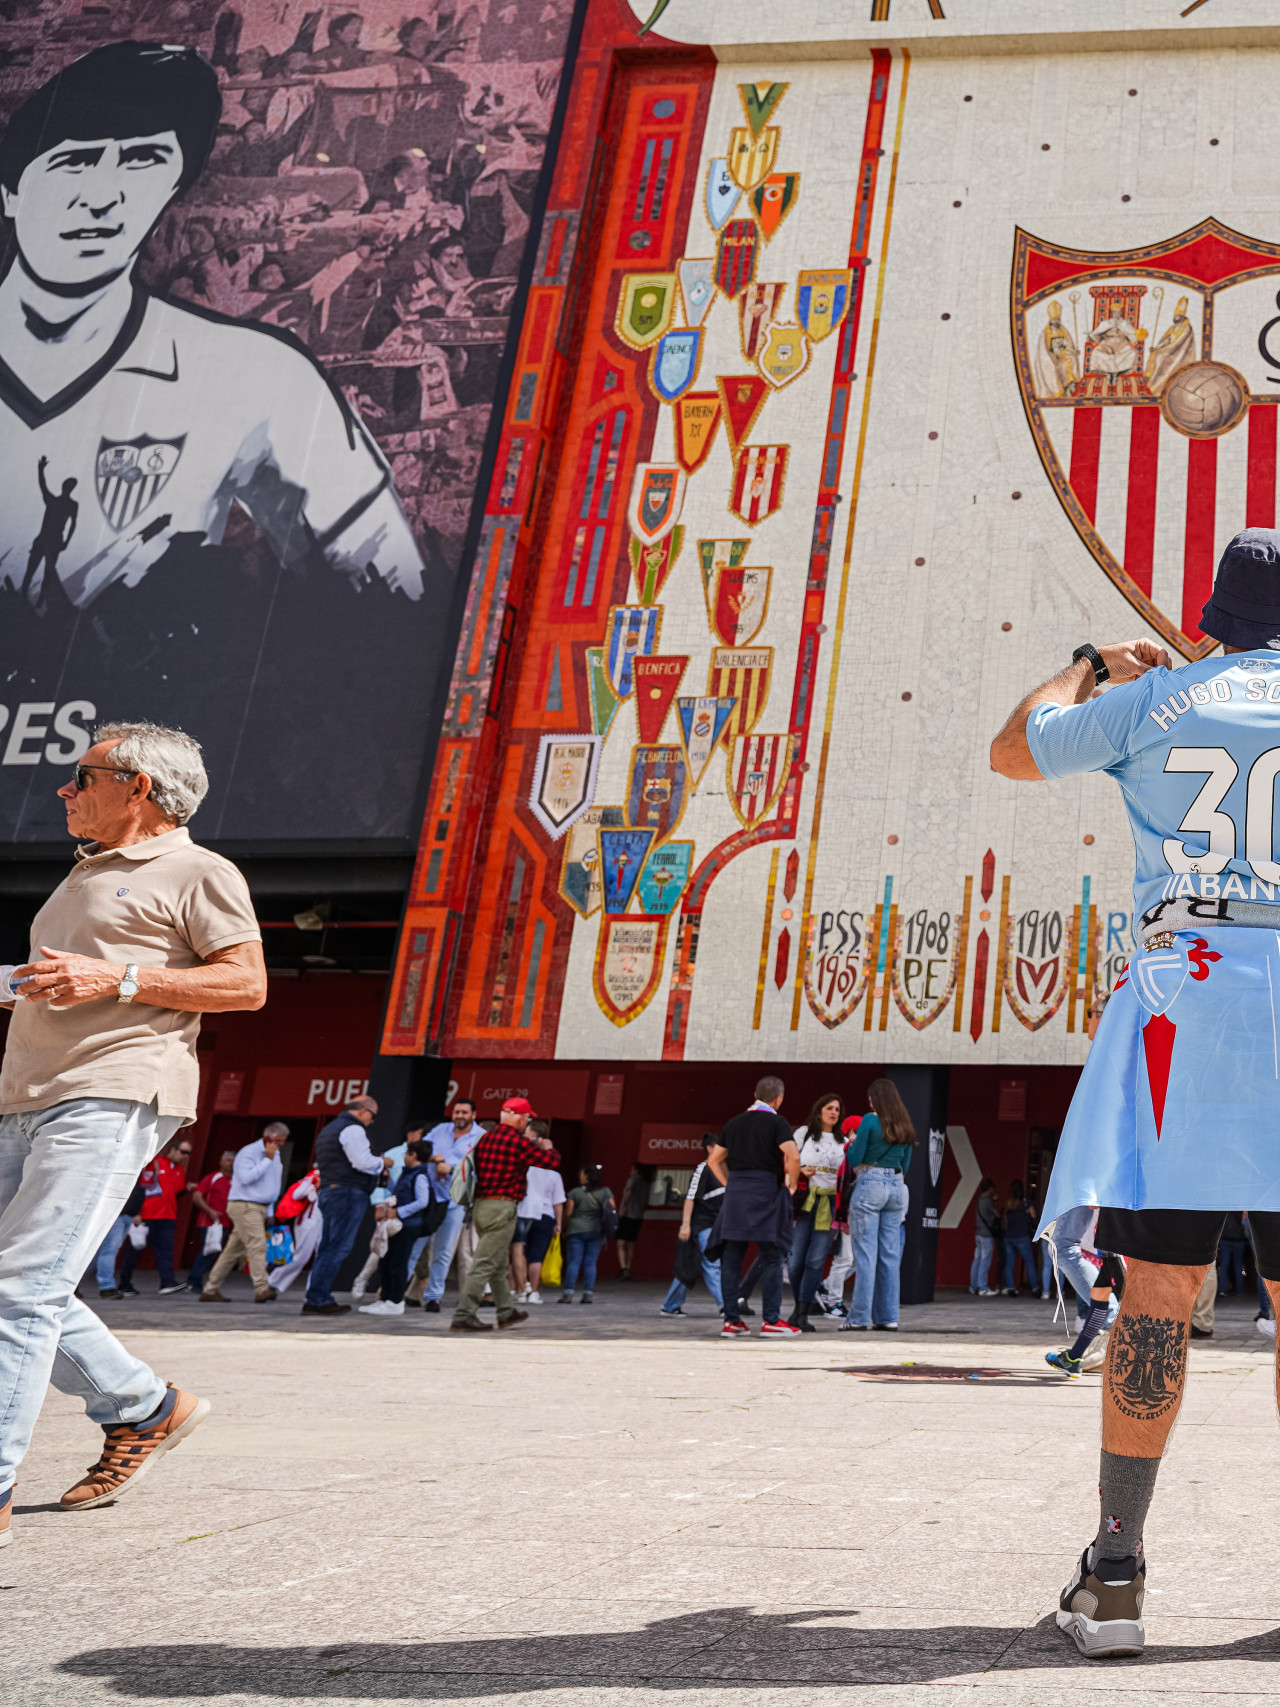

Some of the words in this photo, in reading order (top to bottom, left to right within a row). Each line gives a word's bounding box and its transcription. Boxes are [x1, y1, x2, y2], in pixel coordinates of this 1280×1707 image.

[723, 236, 756, 247] MILAN
[716, 653, 757, 667] VALENCIA
[638, 662, 680, 676] BENFICA
[1149, 679, 1232, 733] HUGO
[609, 833, 643, 846] CELTA
[905, 908, 951, 956] 1908
[1016, 909, 1063, 958] 1910
[816, 951, 859, 1007] 1905
[483, 1088, 513, 1100] GATE
[649, 1138, 689, 1150] OFICINA
